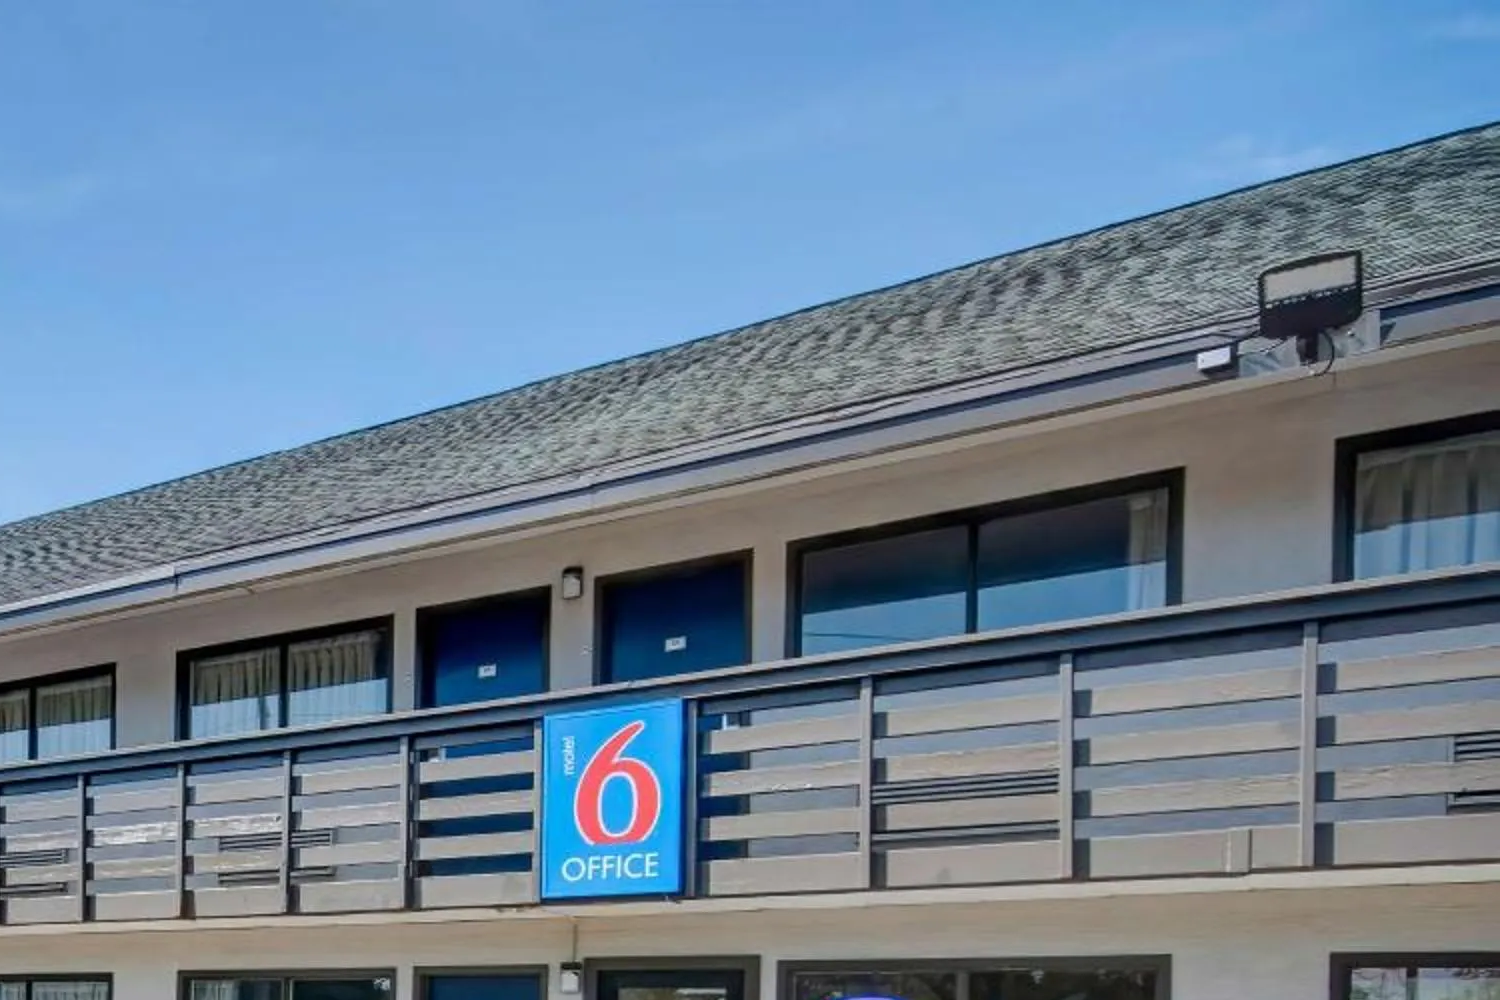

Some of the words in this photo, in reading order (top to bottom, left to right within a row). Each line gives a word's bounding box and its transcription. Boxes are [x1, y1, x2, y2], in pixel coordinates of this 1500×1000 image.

[562, 735, 576, 776] motel
[574, 719, 662, 846] 6
[561, 852, 659, 882] OFFICE
